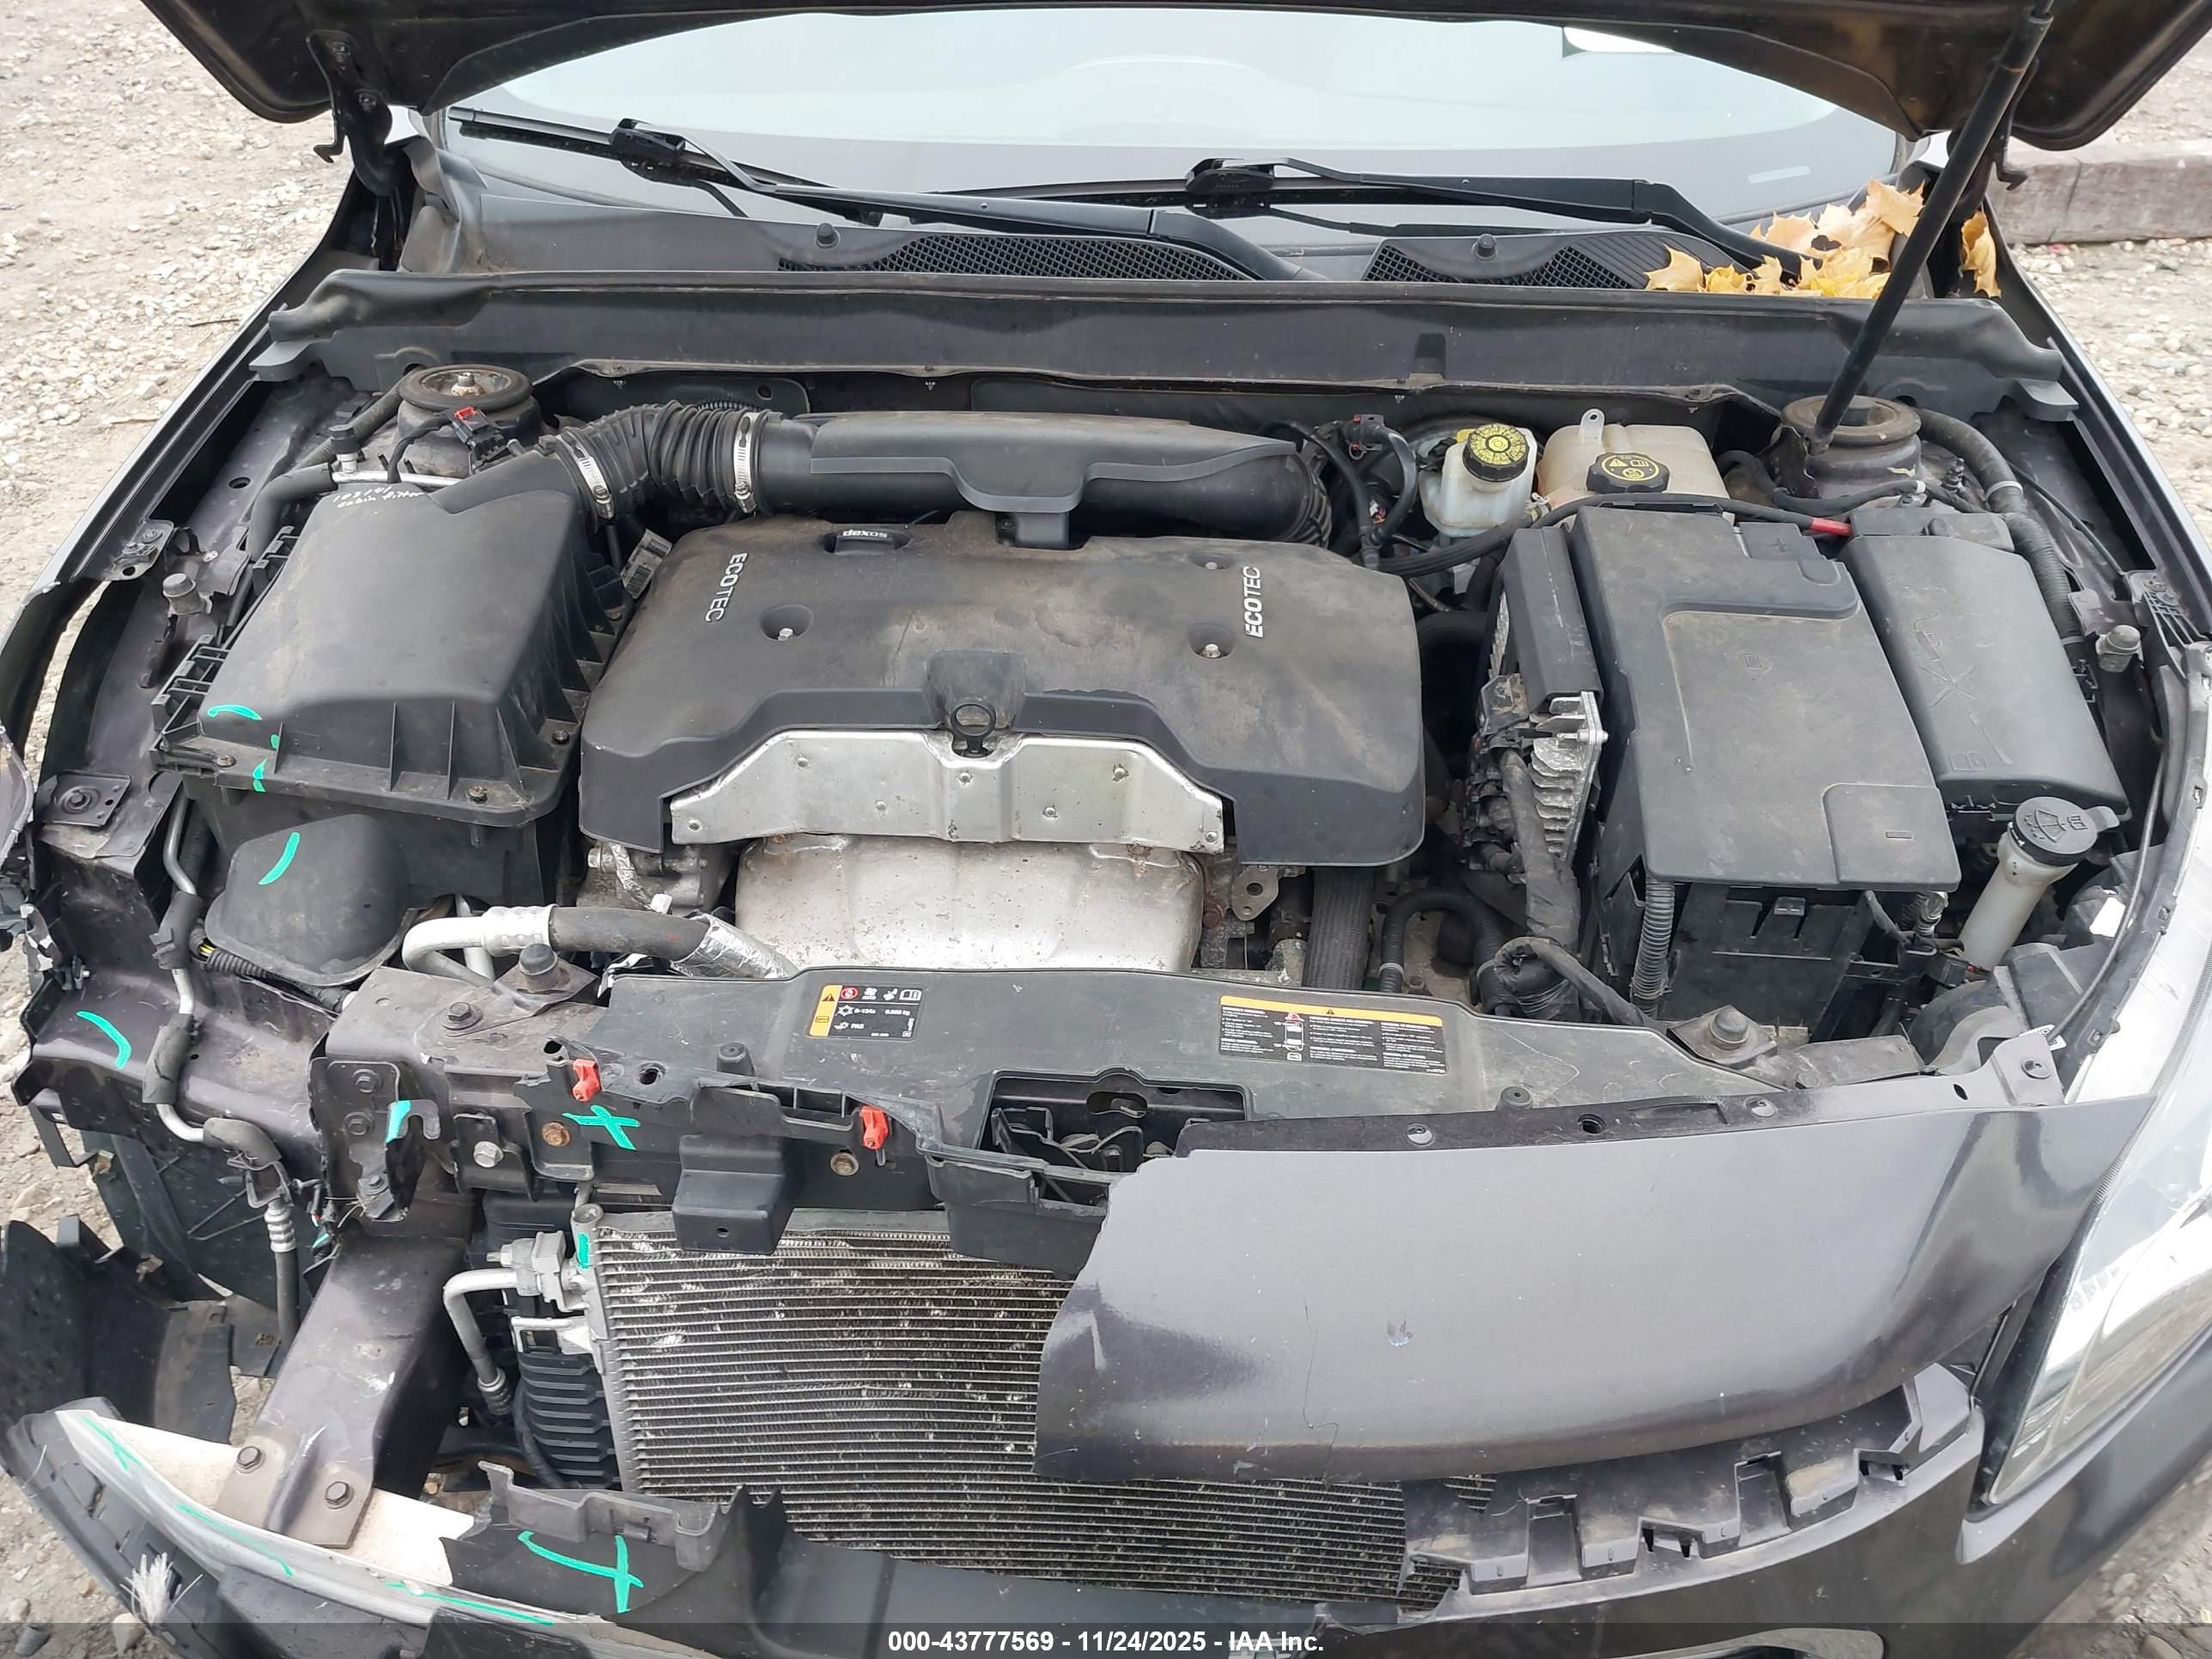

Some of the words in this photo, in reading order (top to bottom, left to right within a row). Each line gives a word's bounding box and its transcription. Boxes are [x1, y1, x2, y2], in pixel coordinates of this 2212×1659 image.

[842, 528, 888, 538] dexos
[704, 551, 748, 623] ECOTEC
[1243, 566, 1263, 638] ECOTEC
